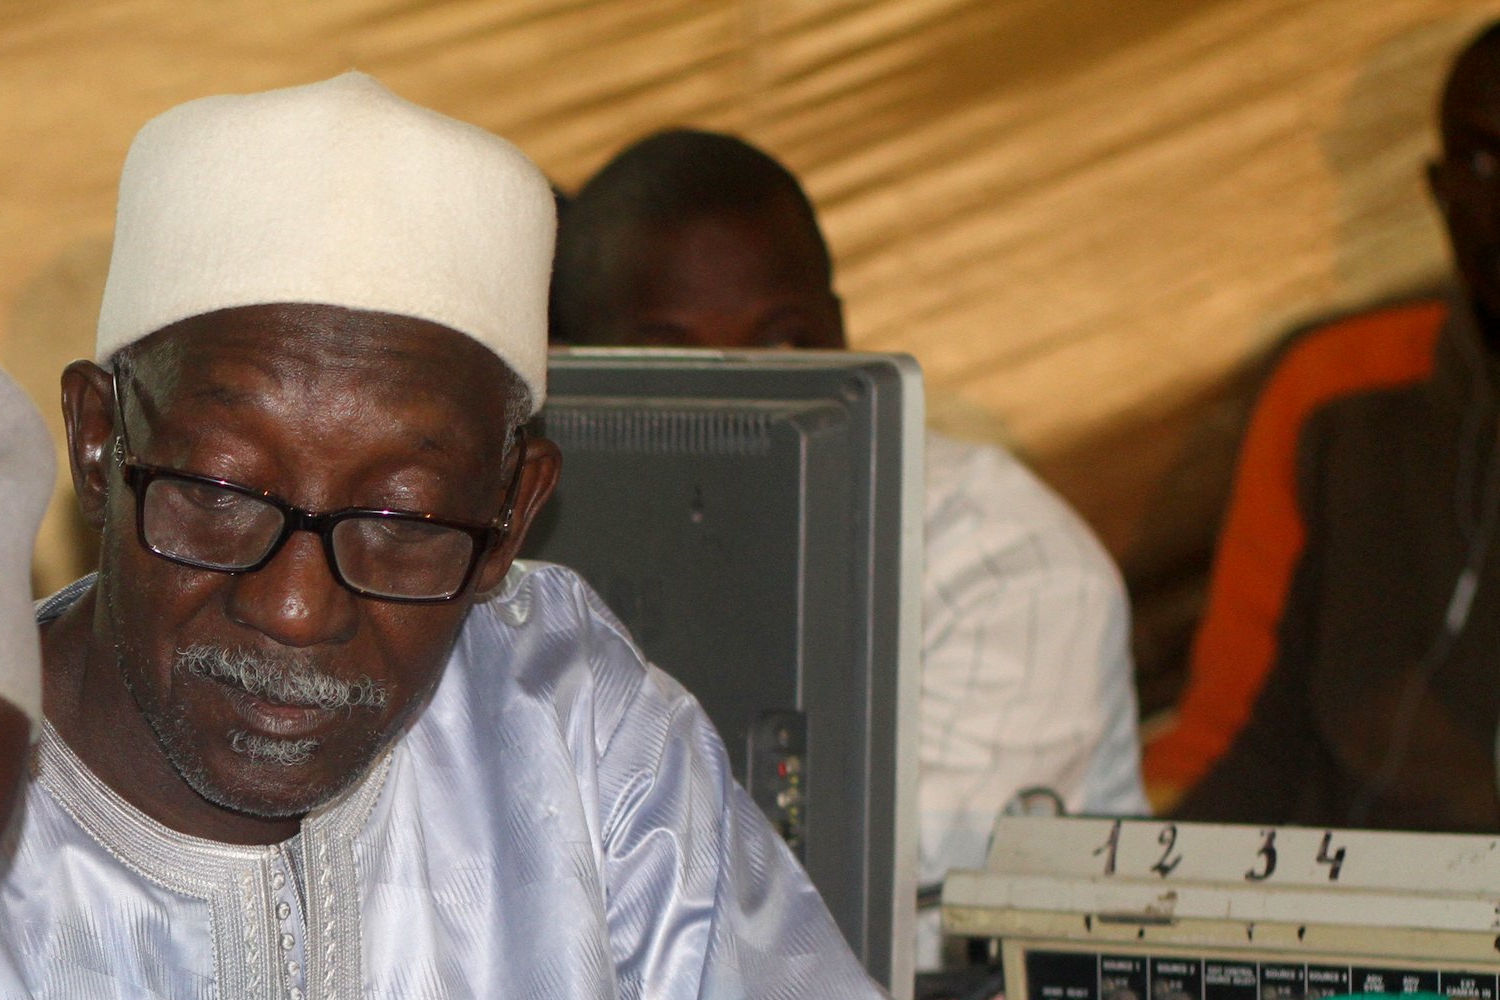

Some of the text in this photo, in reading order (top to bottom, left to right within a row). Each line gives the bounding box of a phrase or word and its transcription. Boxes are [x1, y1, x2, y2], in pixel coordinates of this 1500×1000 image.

[1093, 819, 1346, 881] 1 2 3 4
